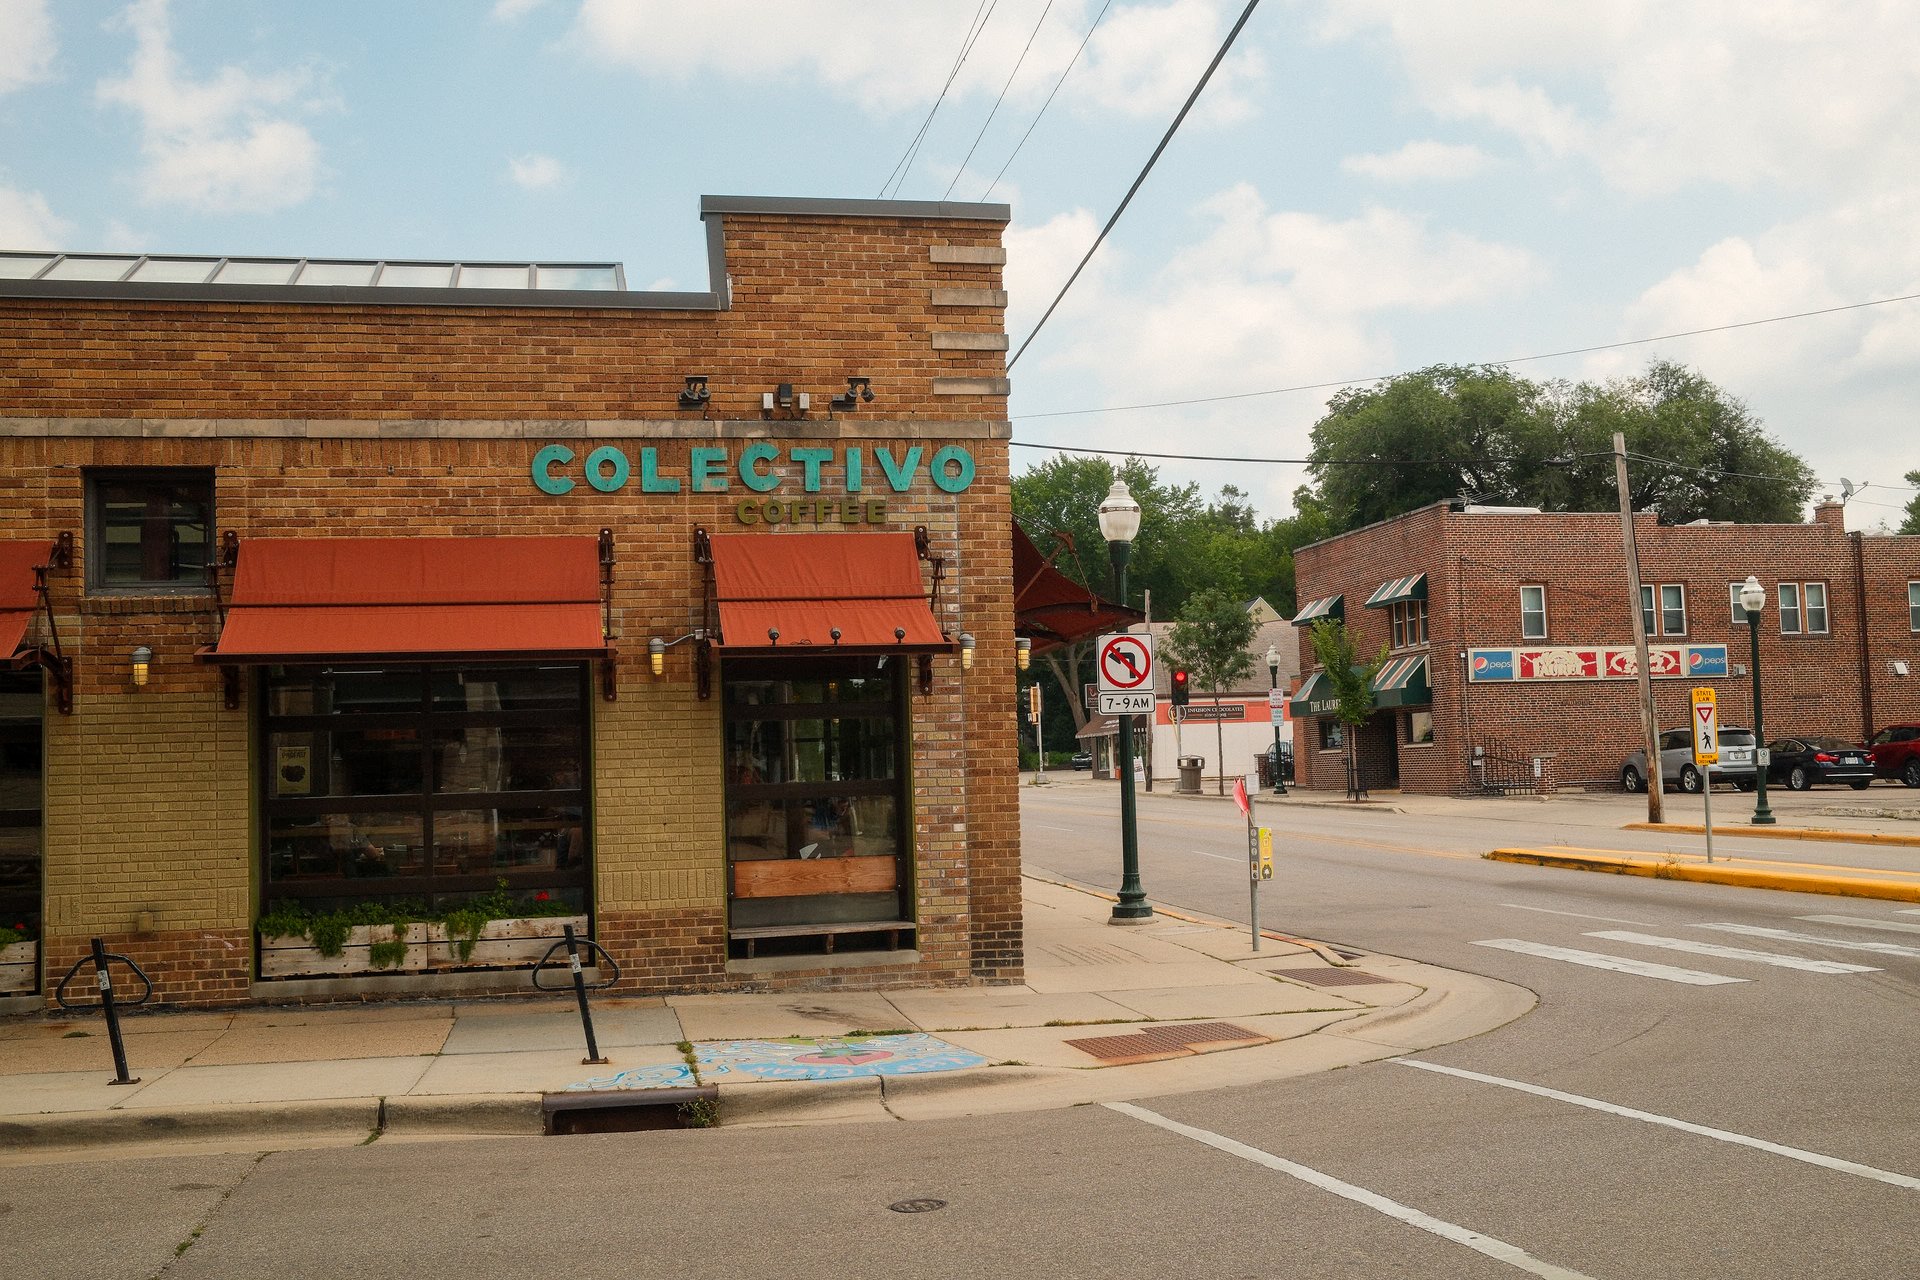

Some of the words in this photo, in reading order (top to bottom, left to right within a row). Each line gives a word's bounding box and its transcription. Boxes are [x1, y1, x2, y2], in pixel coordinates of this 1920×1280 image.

[531, 442, 977, 496] COLECTIVO
[736, 499, 888, 525] COFFEE
[1132, 698, 1149, 708] AM
[1309, 701, 1321, 713] THE
